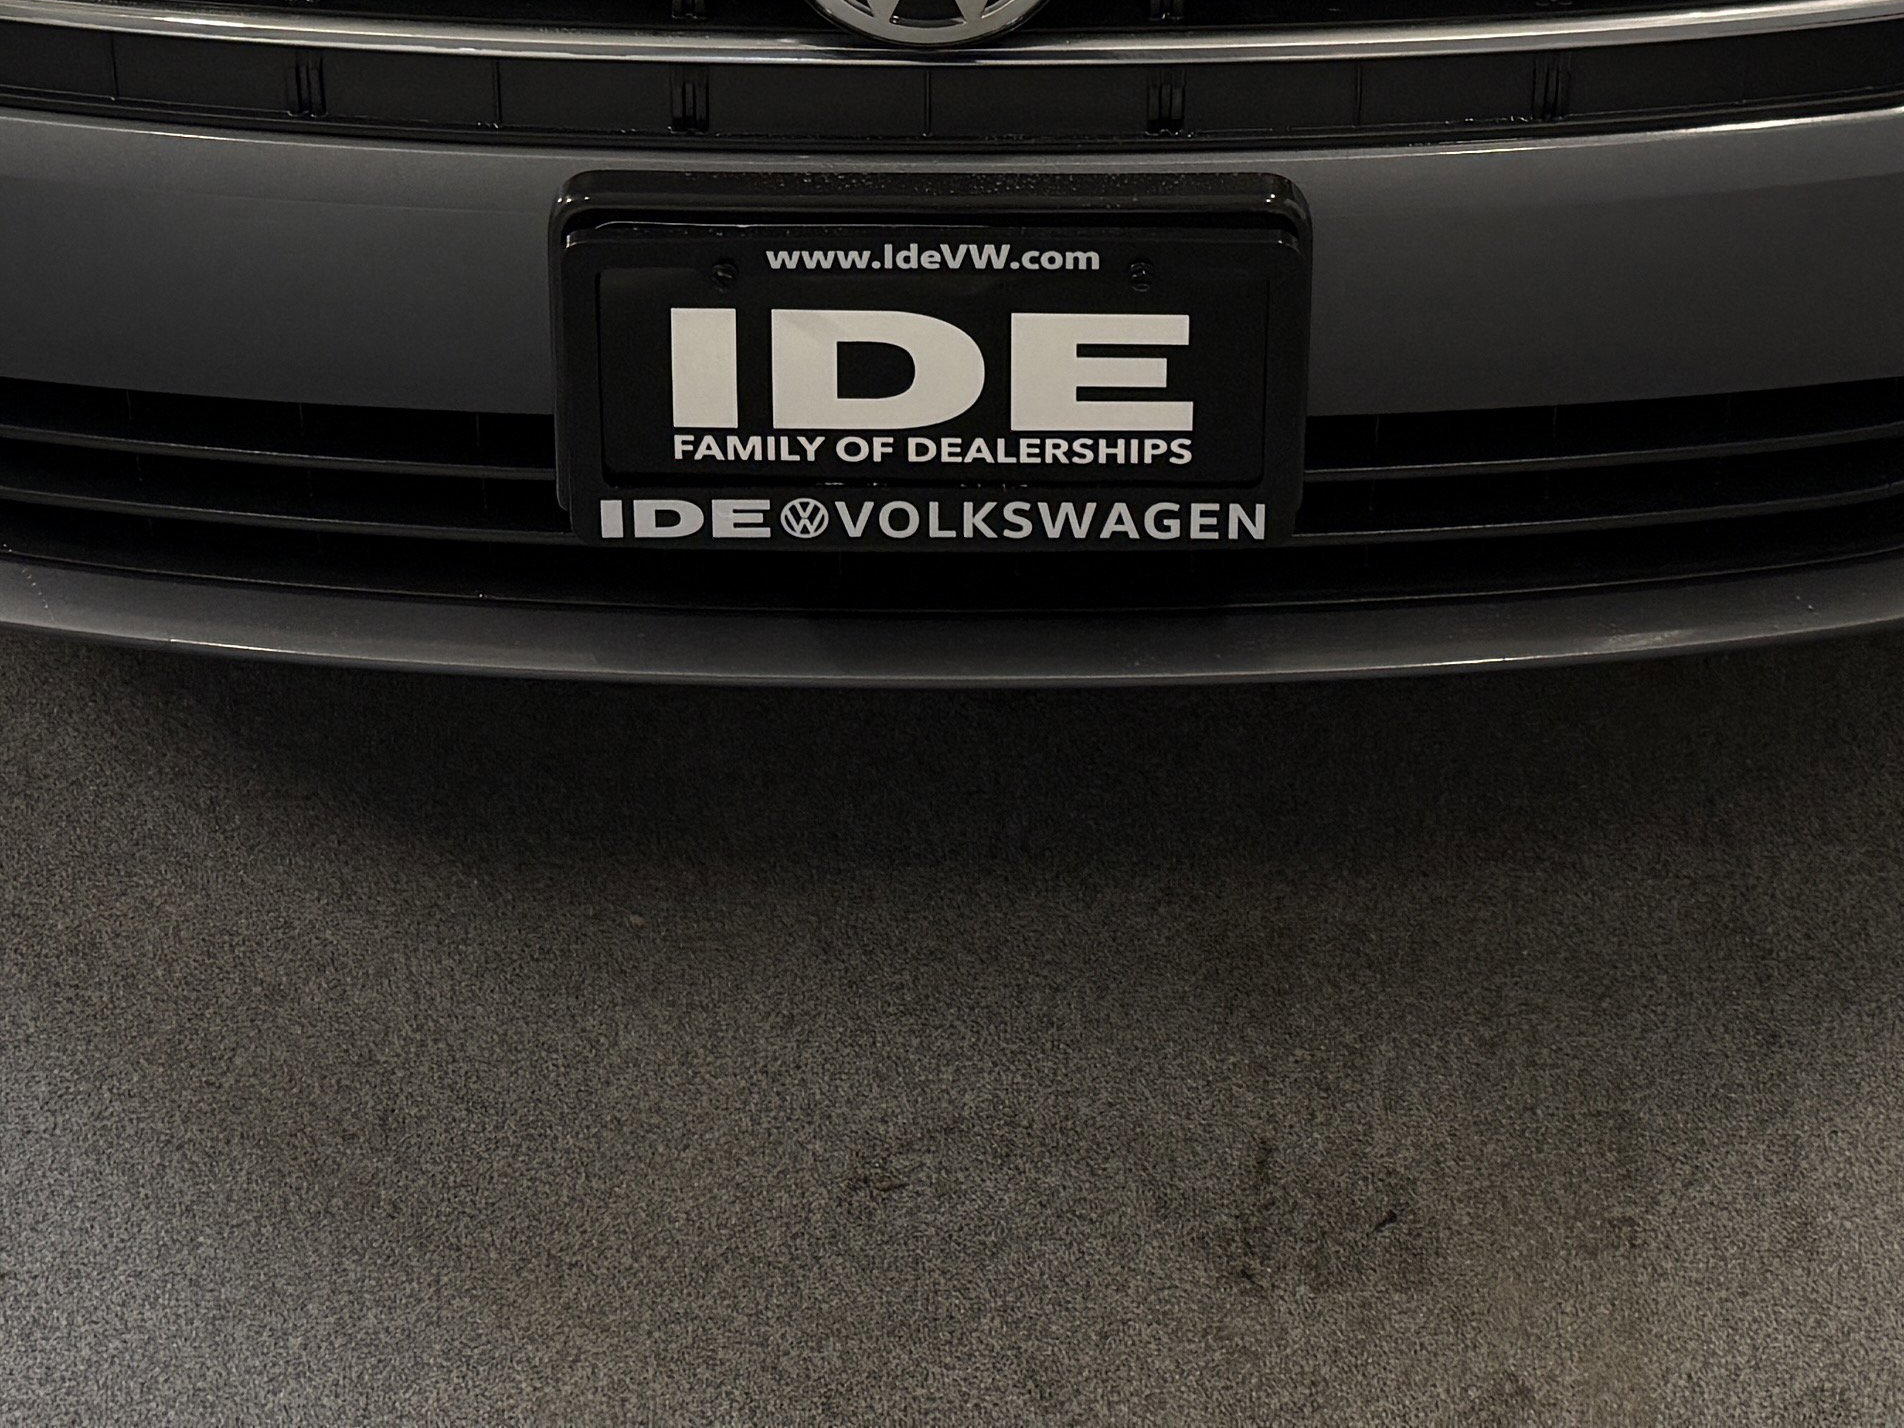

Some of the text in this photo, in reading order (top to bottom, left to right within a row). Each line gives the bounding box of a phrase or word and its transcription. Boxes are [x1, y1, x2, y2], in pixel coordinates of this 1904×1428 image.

[765, 243, 1100, 270] www.IdeVW.com
[670, 307, 1194, 432] IDE
[673, 434, 1193, 465] FAMILY OF DEALERSHIPS
[600, 499, 771, 539] IDE
[834, 500, 1266, 540] VOLKSWAGEN
